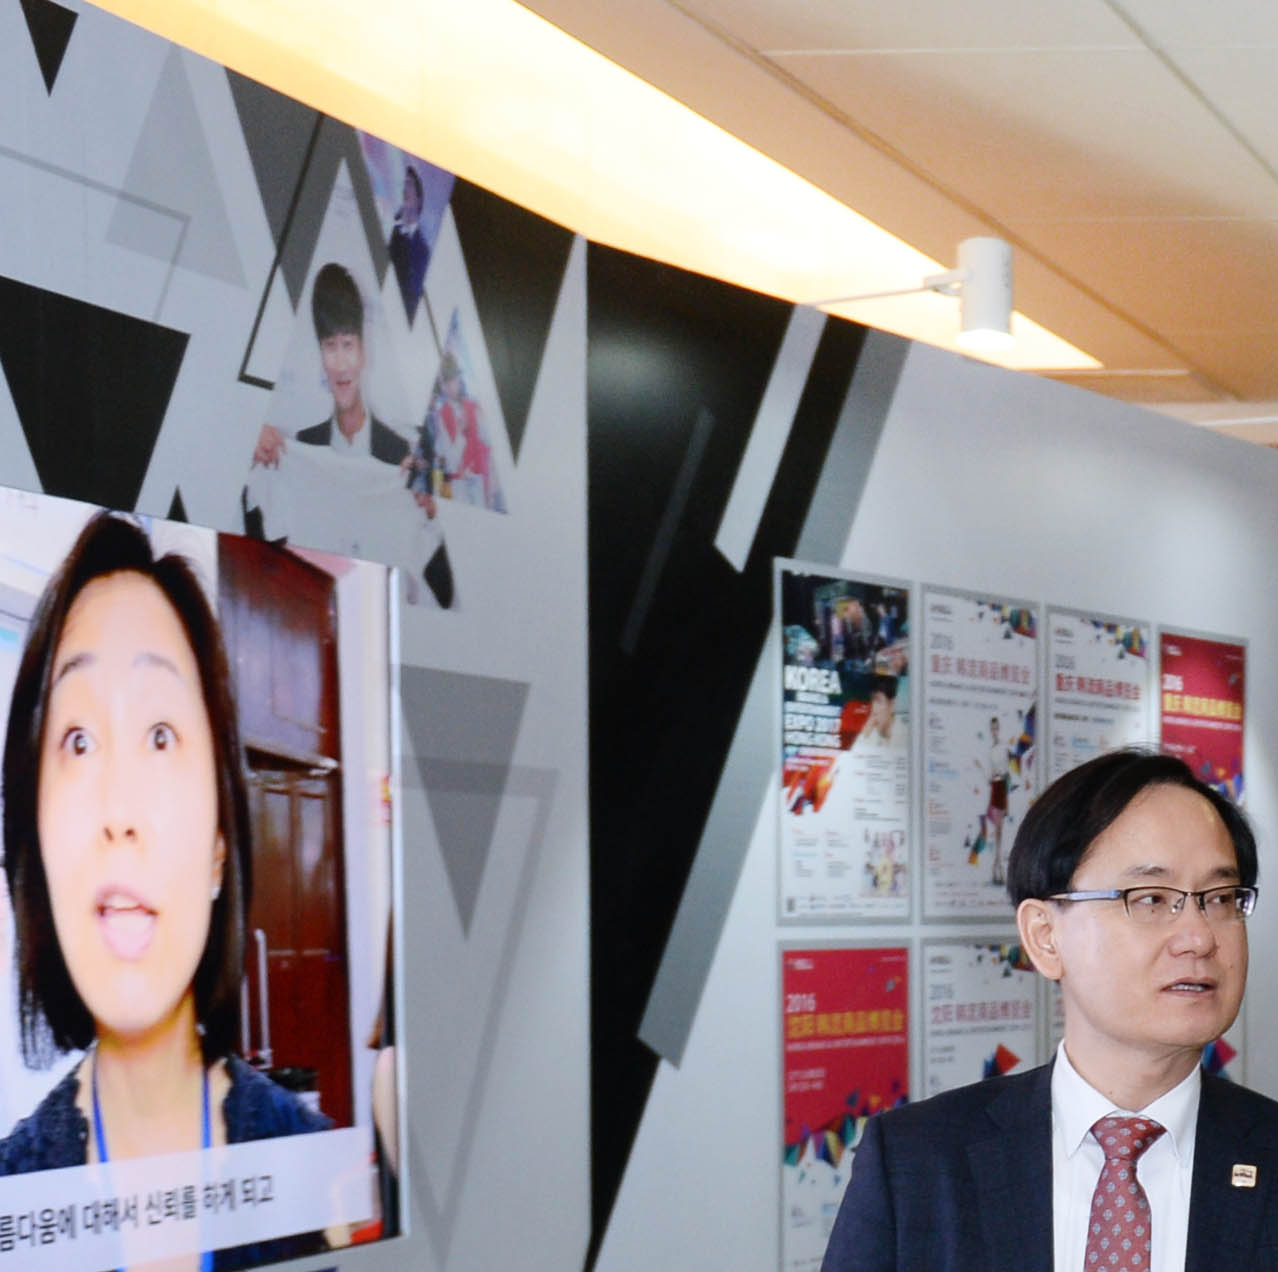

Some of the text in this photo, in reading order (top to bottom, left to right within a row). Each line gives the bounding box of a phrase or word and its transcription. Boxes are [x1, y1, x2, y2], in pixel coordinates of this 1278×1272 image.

[784, 665, 843, 695] KOREA
[786, 993, 816, 1012] 2016
[83, 1194, 138, 1234] 대해서
[202, 1179, 236, 1214] 하게
[241, 1174, 274, 1206] 되고
